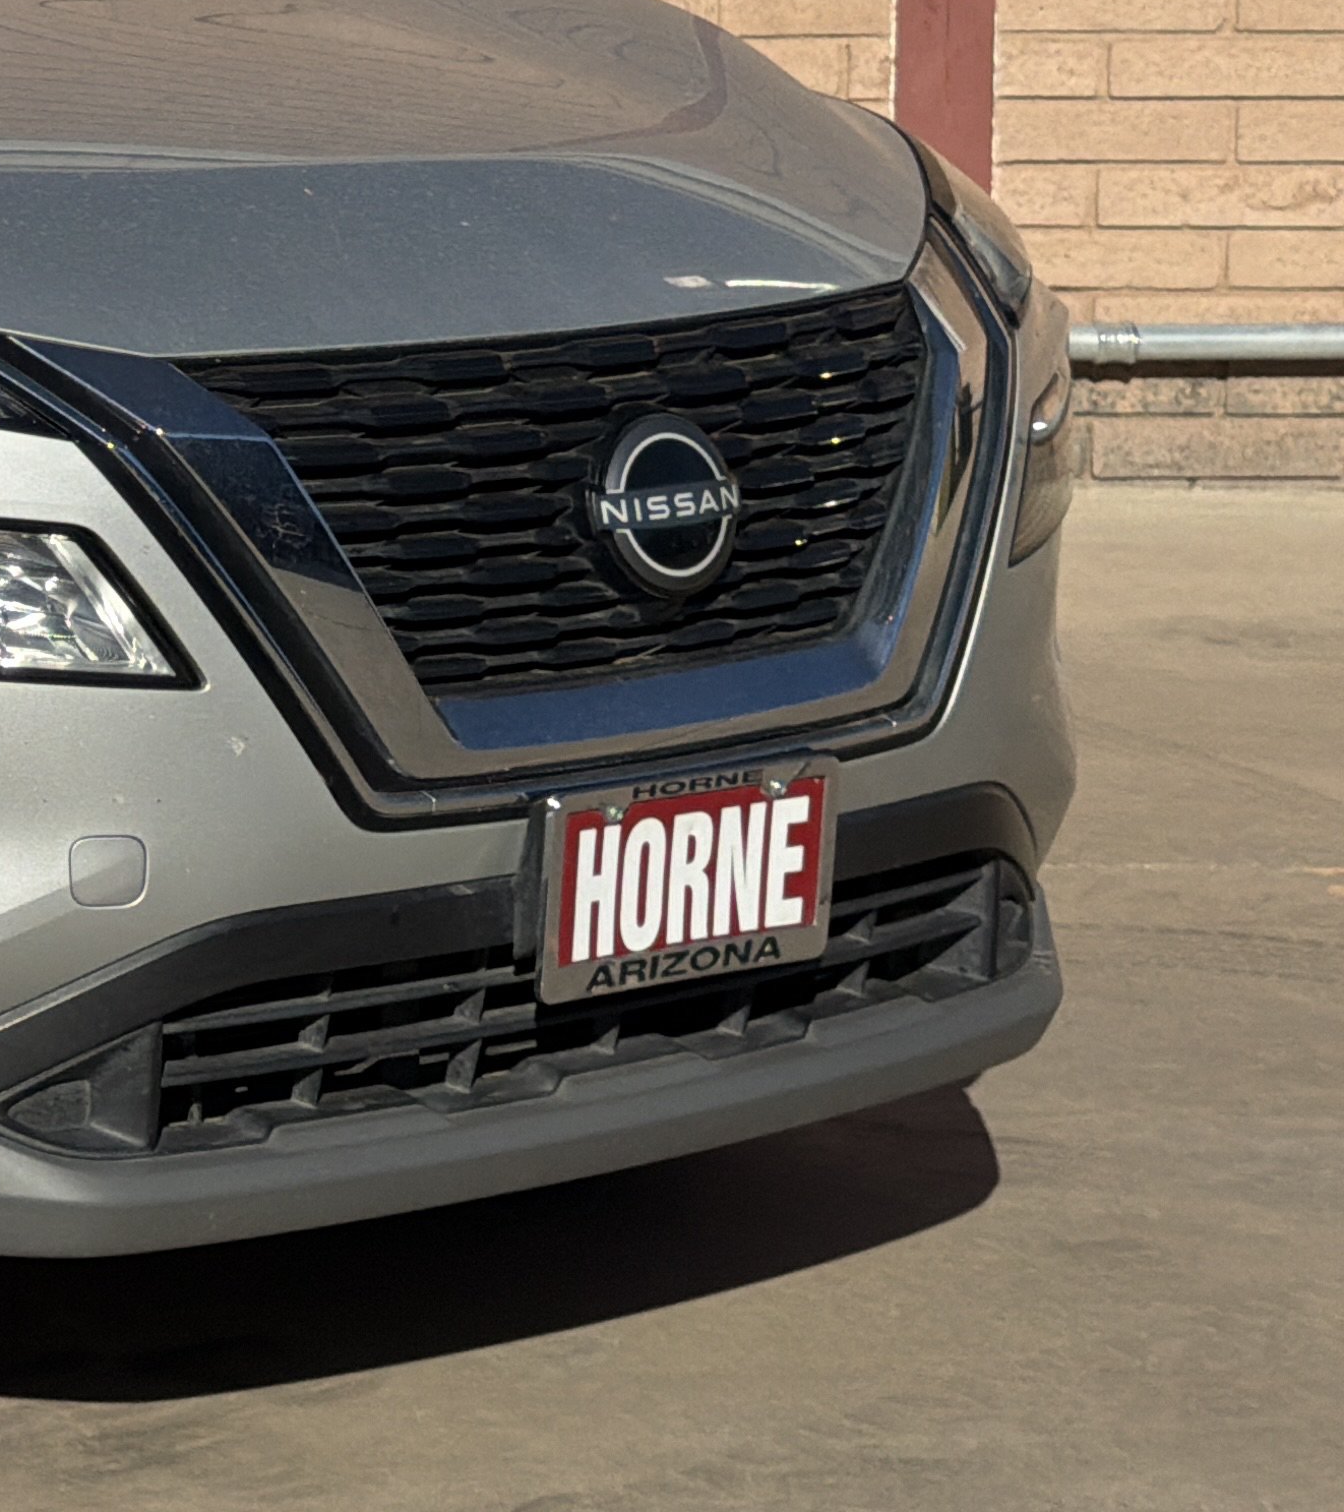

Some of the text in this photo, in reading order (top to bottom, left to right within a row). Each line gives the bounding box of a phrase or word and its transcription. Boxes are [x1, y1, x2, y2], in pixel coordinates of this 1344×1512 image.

[600, 484, 739, 525] NISSAN
[631, 770, 761, 799] HORNE
[571, 794, 810, 963] HORNE
[585, 935, 781, 991] ARIZONA
